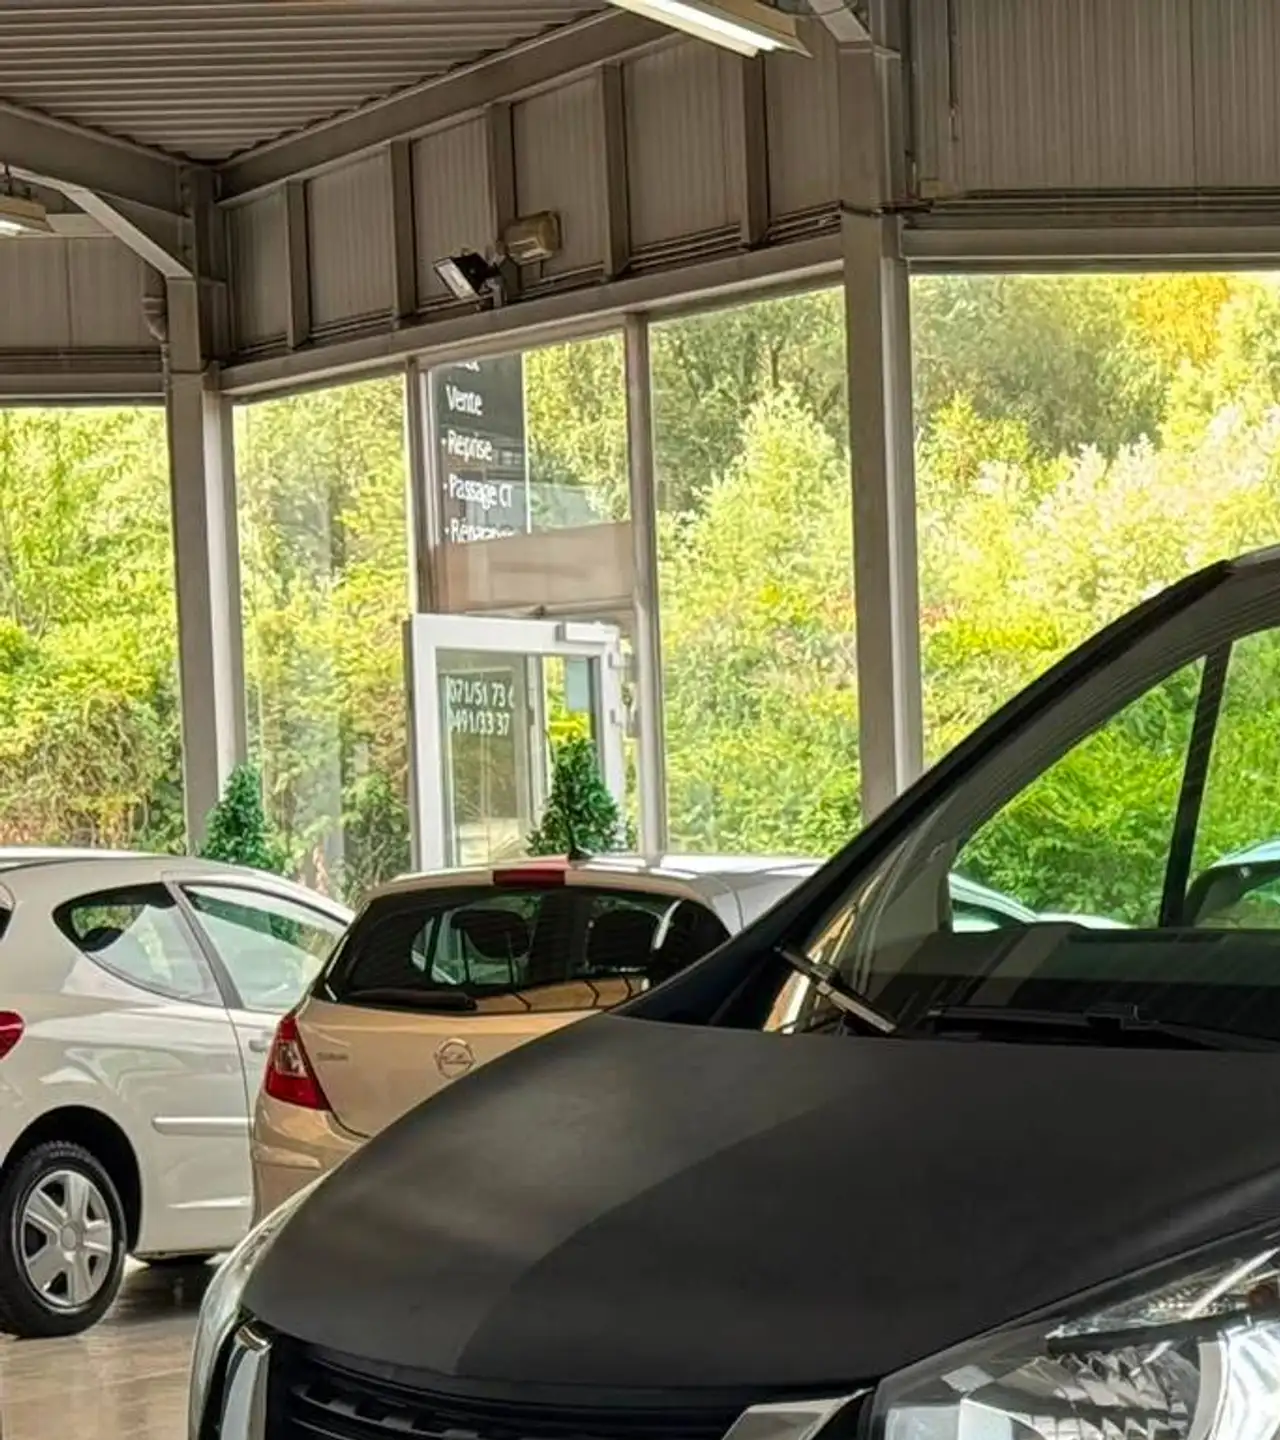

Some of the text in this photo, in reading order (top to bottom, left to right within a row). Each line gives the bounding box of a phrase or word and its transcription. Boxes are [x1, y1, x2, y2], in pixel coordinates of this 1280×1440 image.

[446, 383, 482, 416] Vente
[449, 473, 513, 510] Passage CT
